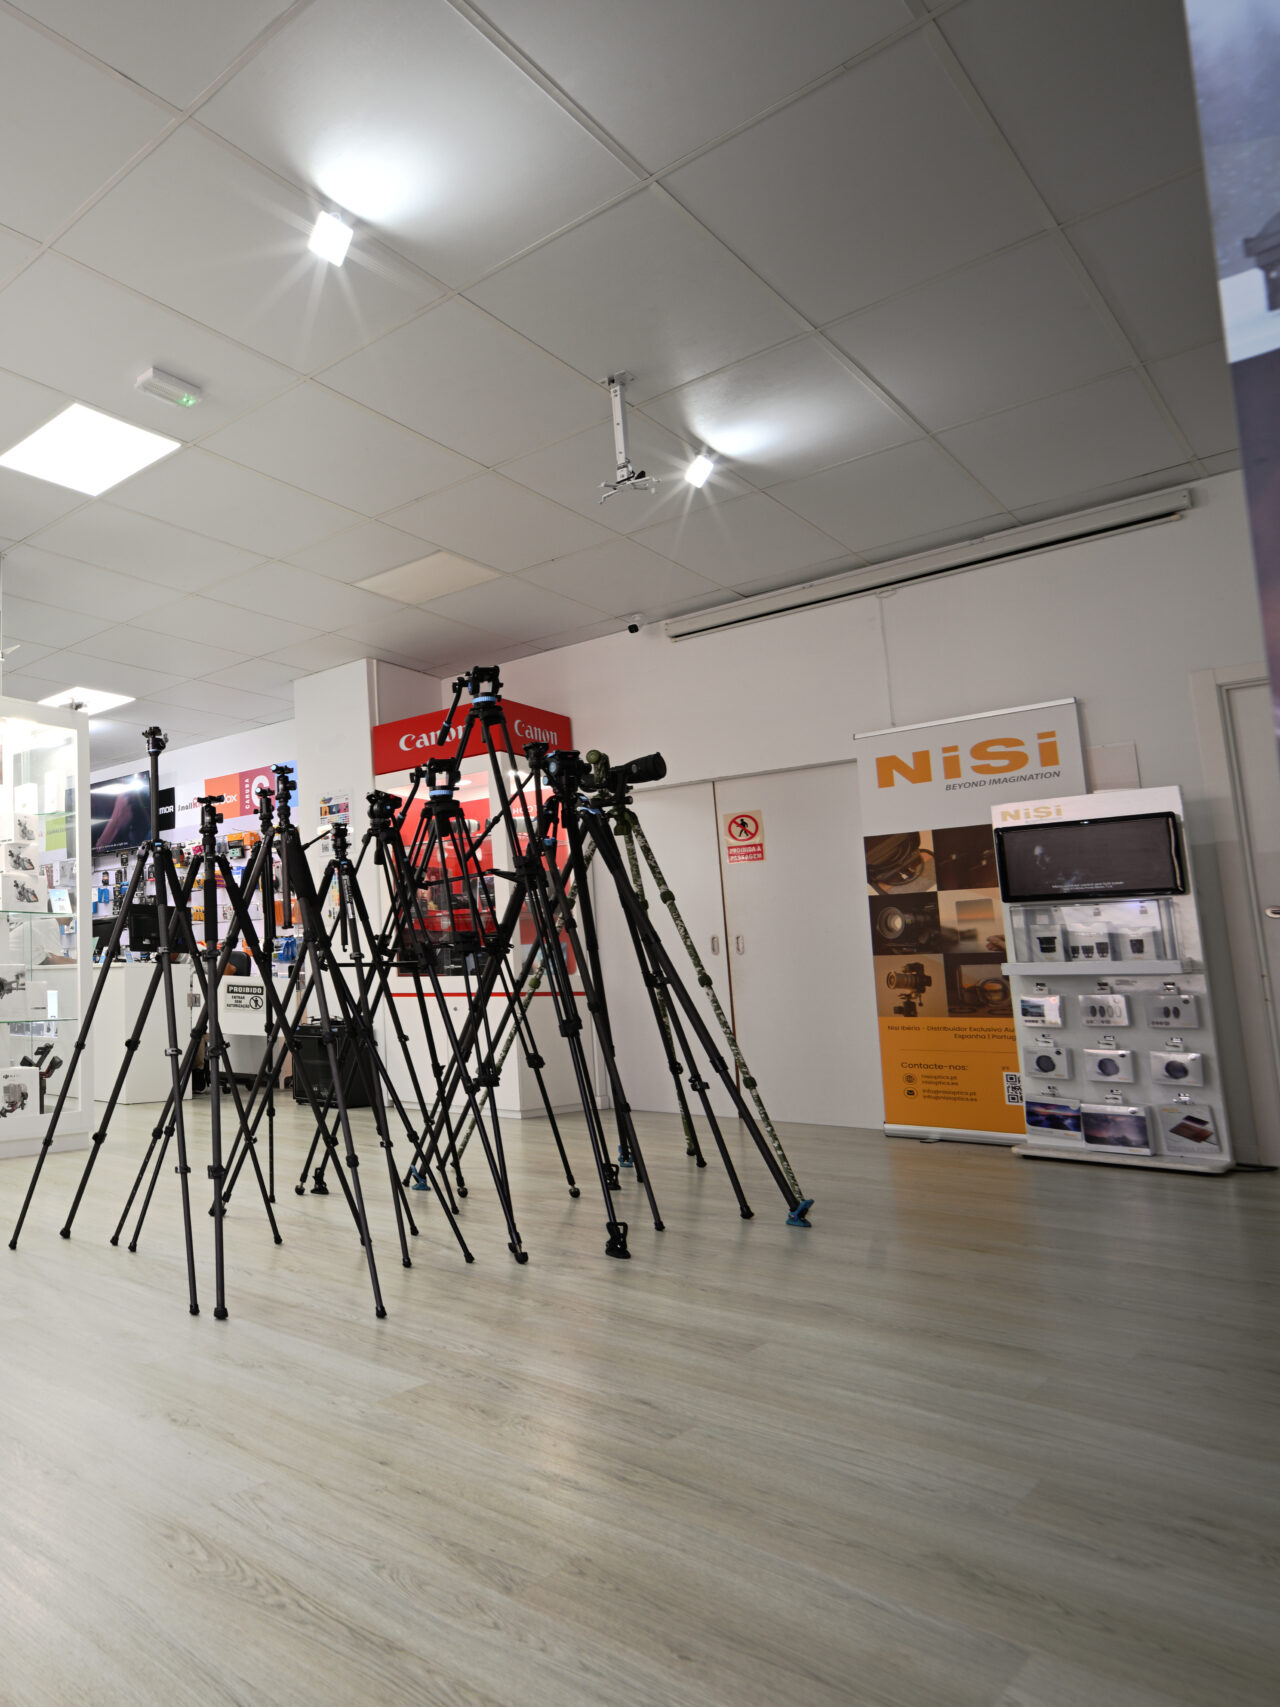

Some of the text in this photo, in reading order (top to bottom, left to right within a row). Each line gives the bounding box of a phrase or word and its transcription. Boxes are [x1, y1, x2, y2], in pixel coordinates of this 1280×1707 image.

[513, 719, 558, 746] Canon
[875, 730, 1060, 789] NiSi
[945, 770, 1061, 791] BEYOND IMAGINATION
[1000, 804, 1063, 822] NiSi
[228, 986, 262, 994] PROIBIDO
[953, 1033, 986, 1041] Espanha
[900, 1061, 968, 1071] Contacte-nos:
